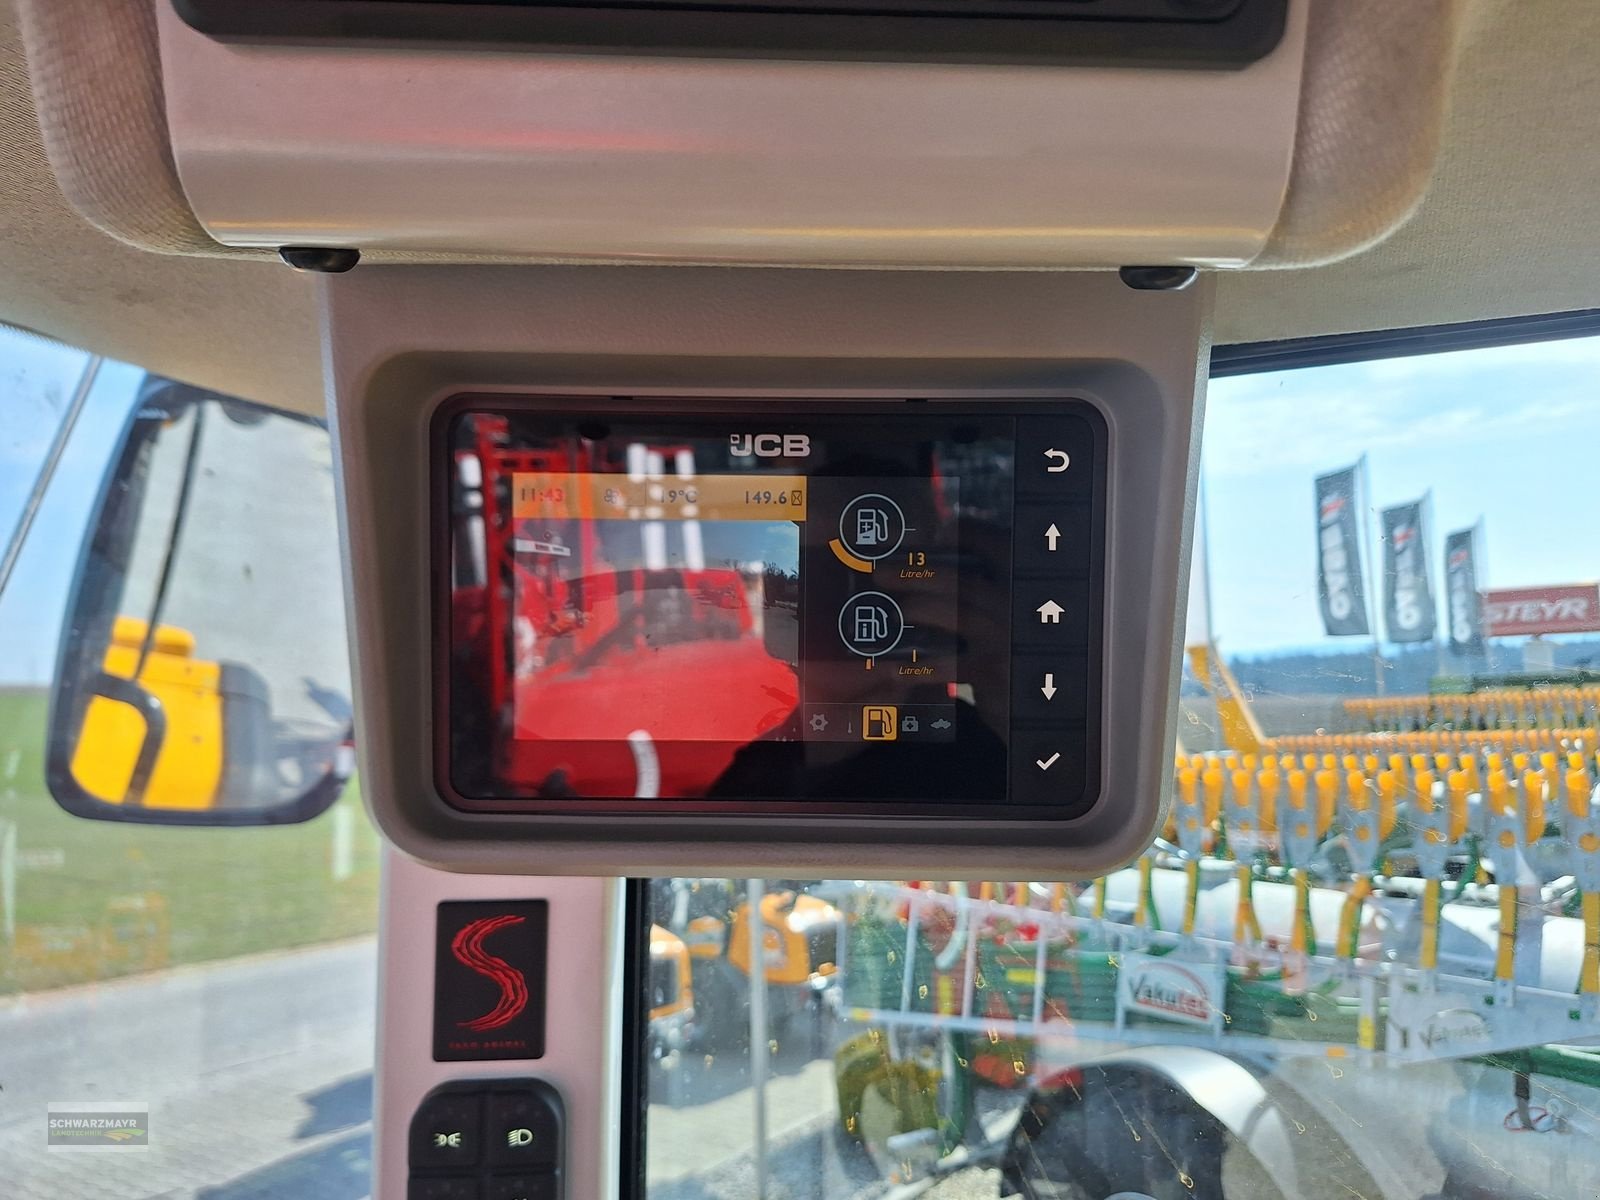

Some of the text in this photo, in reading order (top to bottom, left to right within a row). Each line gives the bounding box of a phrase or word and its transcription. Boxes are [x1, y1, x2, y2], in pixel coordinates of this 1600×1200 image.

[730, 434, 811, 457] JCB
[521, 487, 564, 502] 11:43
[744, 490, 788, 505] 149.6
[909, 552, 926, 566] 13
[900, 569, 936, 578] Litre/hr
[1481, 597, 1588, 624] STEYR
[898, 666, 934, 675] Litre/hr
